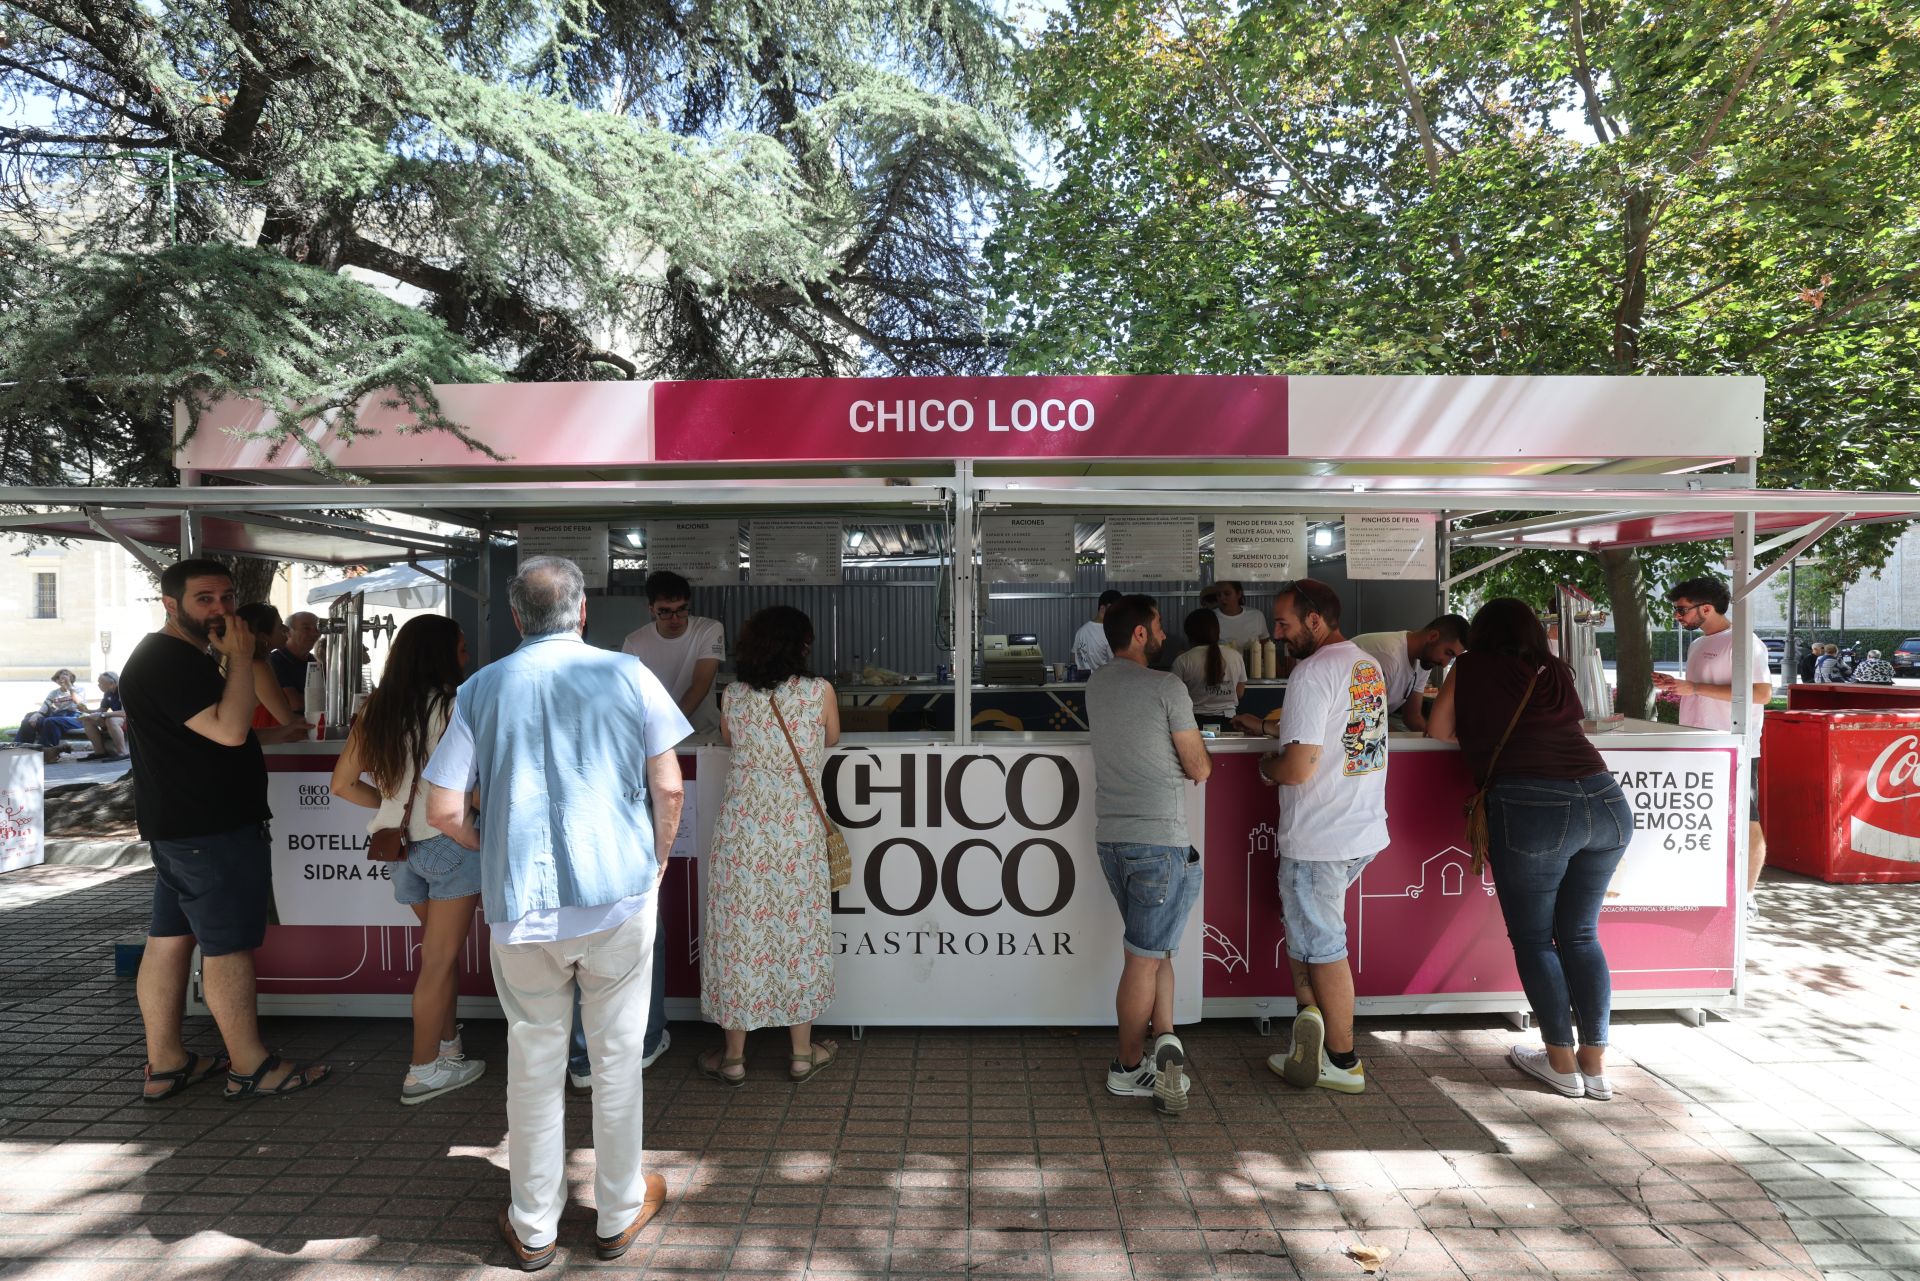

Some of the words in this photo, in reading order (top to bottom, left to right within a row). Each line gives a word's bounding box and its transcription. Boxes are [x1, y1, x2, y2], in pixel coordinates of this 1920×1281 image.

[849, 399, 974, 433] CHICO
[988, 398, 1095, 432] LOCO
[820, 746, 1080, 831] CHICO
[1685, 772, 1714, 789] DE
[299, 784, 330, 796] CHICO
[300, 795, 330, 806] LOCO
[1634, 792, 1714, 810] QUESO
[288, 834, 372, 851] BOTELLA
[1663, 833, 1712, 854] 6,5€
[303, 864, 362, 881] SIDRA
[367, 864, 391, 881] 4€
[831, 931, 1075, 957] GASTROBAR
